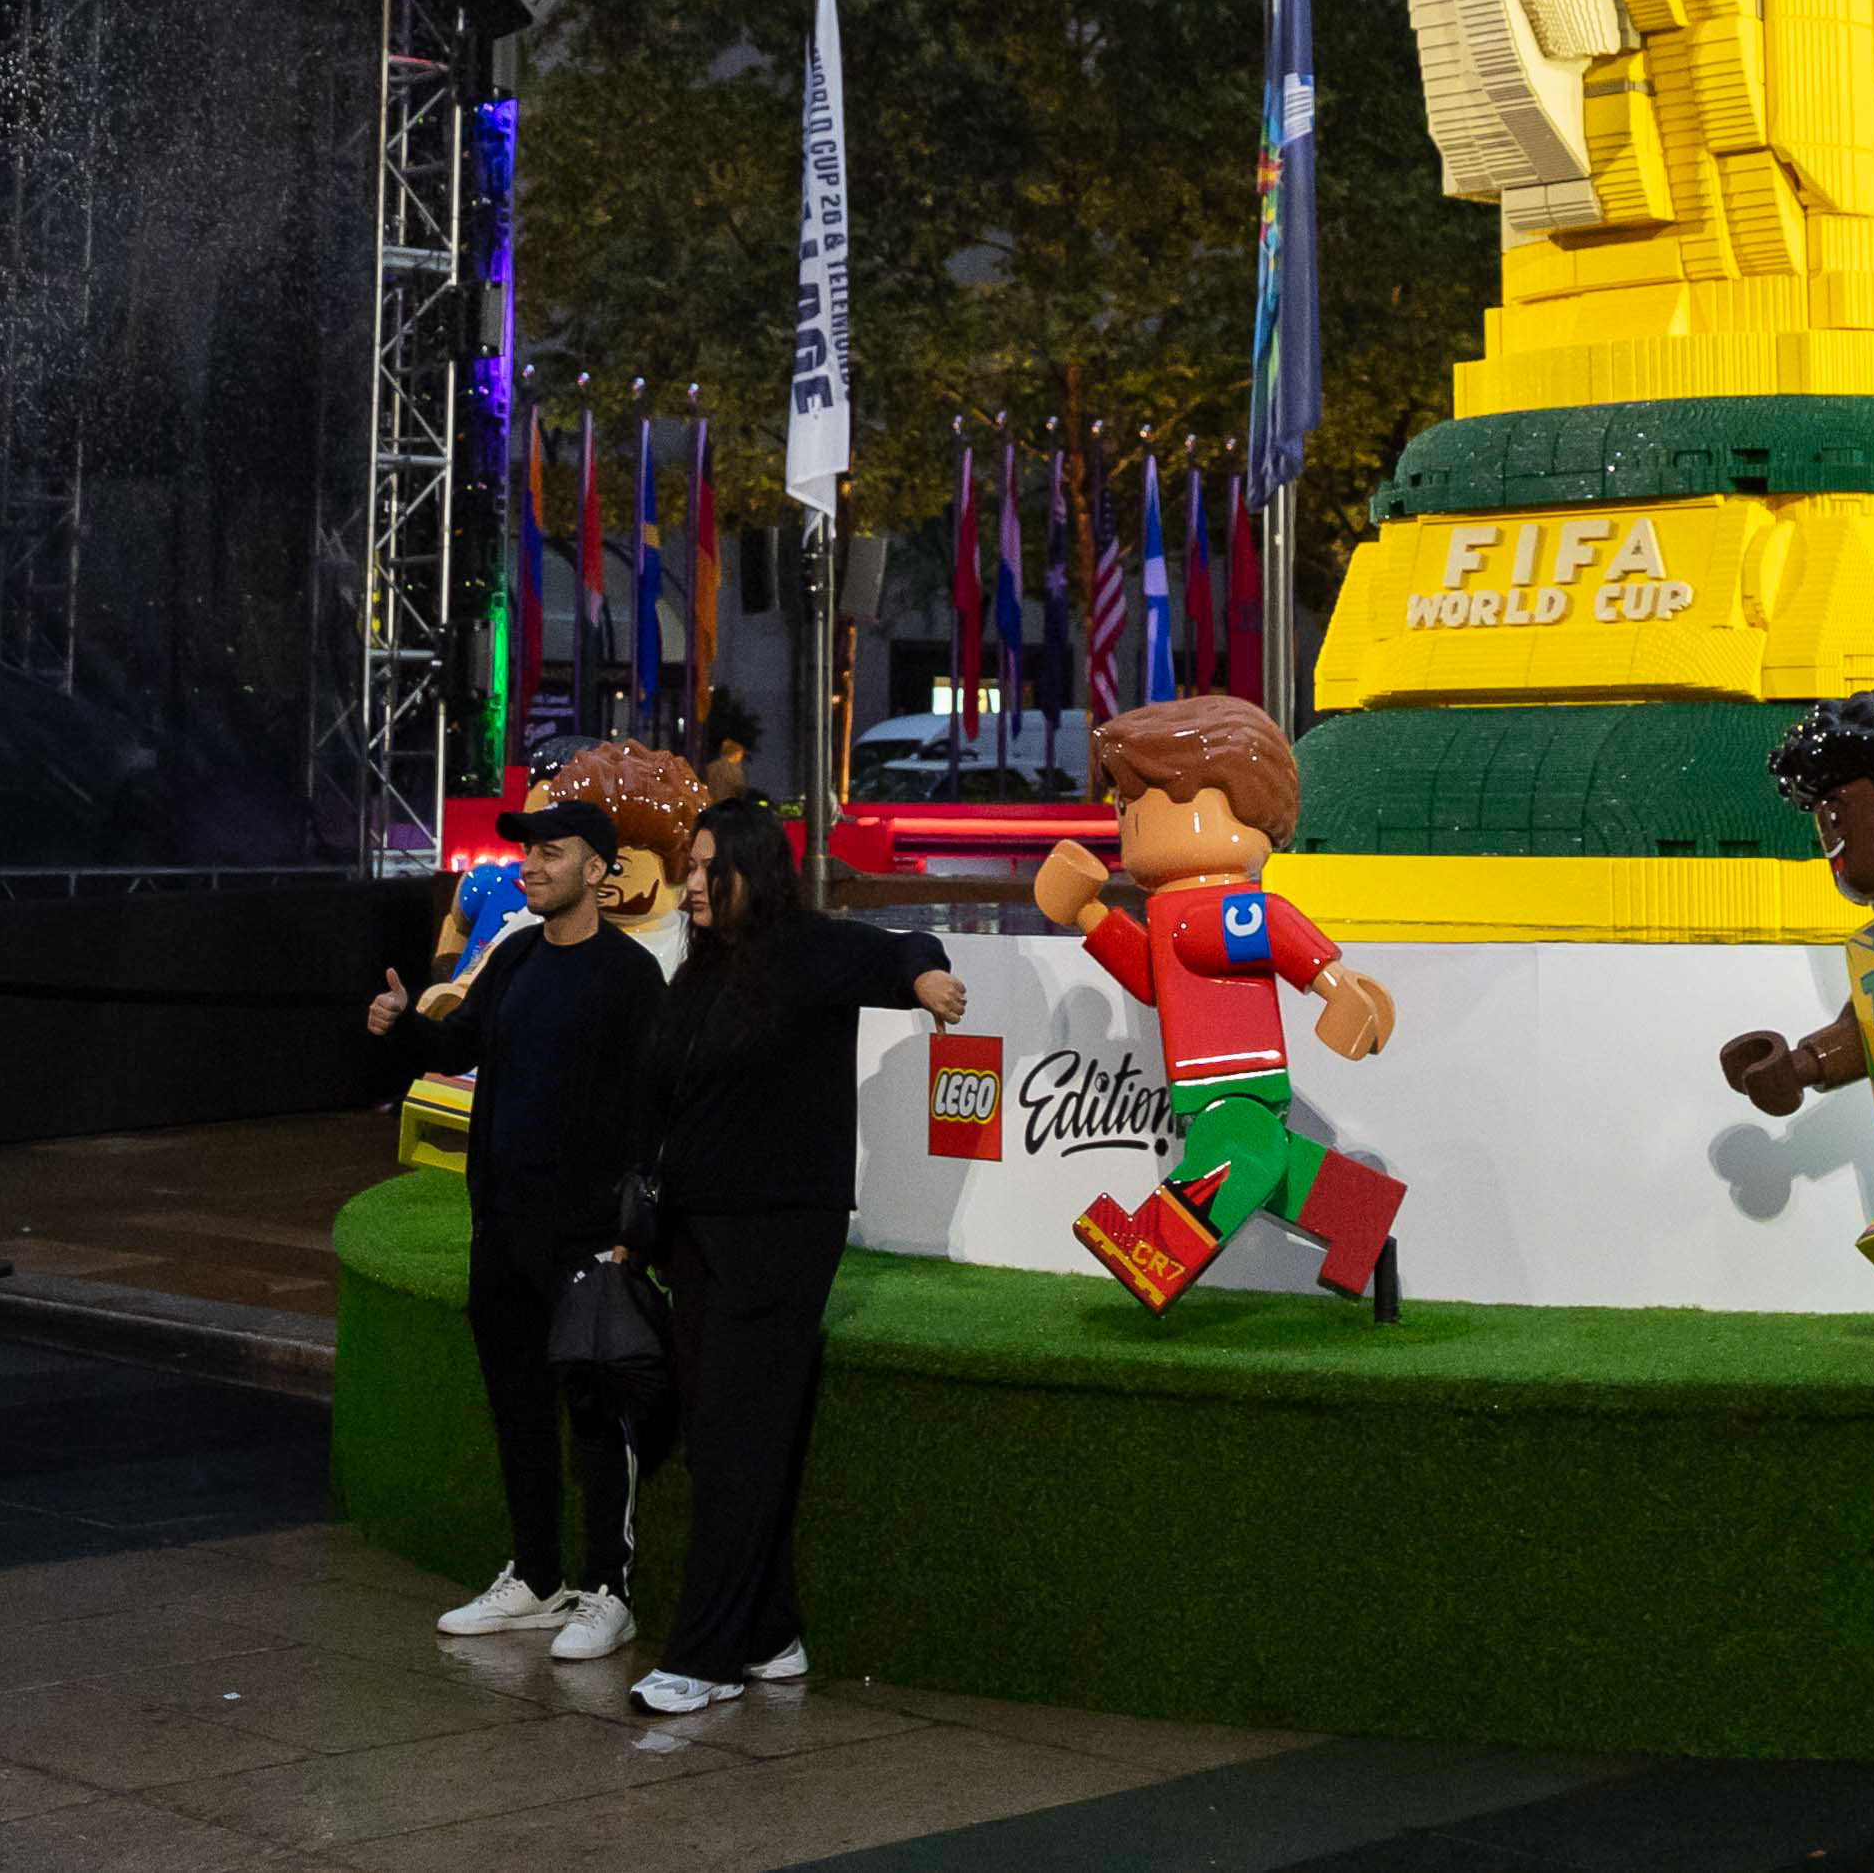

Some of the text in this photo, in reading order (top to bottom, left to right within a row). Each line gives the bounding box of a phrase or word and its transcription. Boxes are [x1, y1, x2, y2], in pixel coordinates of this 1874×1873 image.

[810, 139, 840, 186] CUP
[824, 233, 846, 251] &
[827, 256, 850, 400] TELEMU
[1441, 516, 1668, 589] FIFA
[1405, 579, 1695, 630] WORLD CUP
[1225, 902, 1264, 937] C
[932, 1069, 999, 1123] LEGO
[1131, 1241, 1185, 1281] CR7
